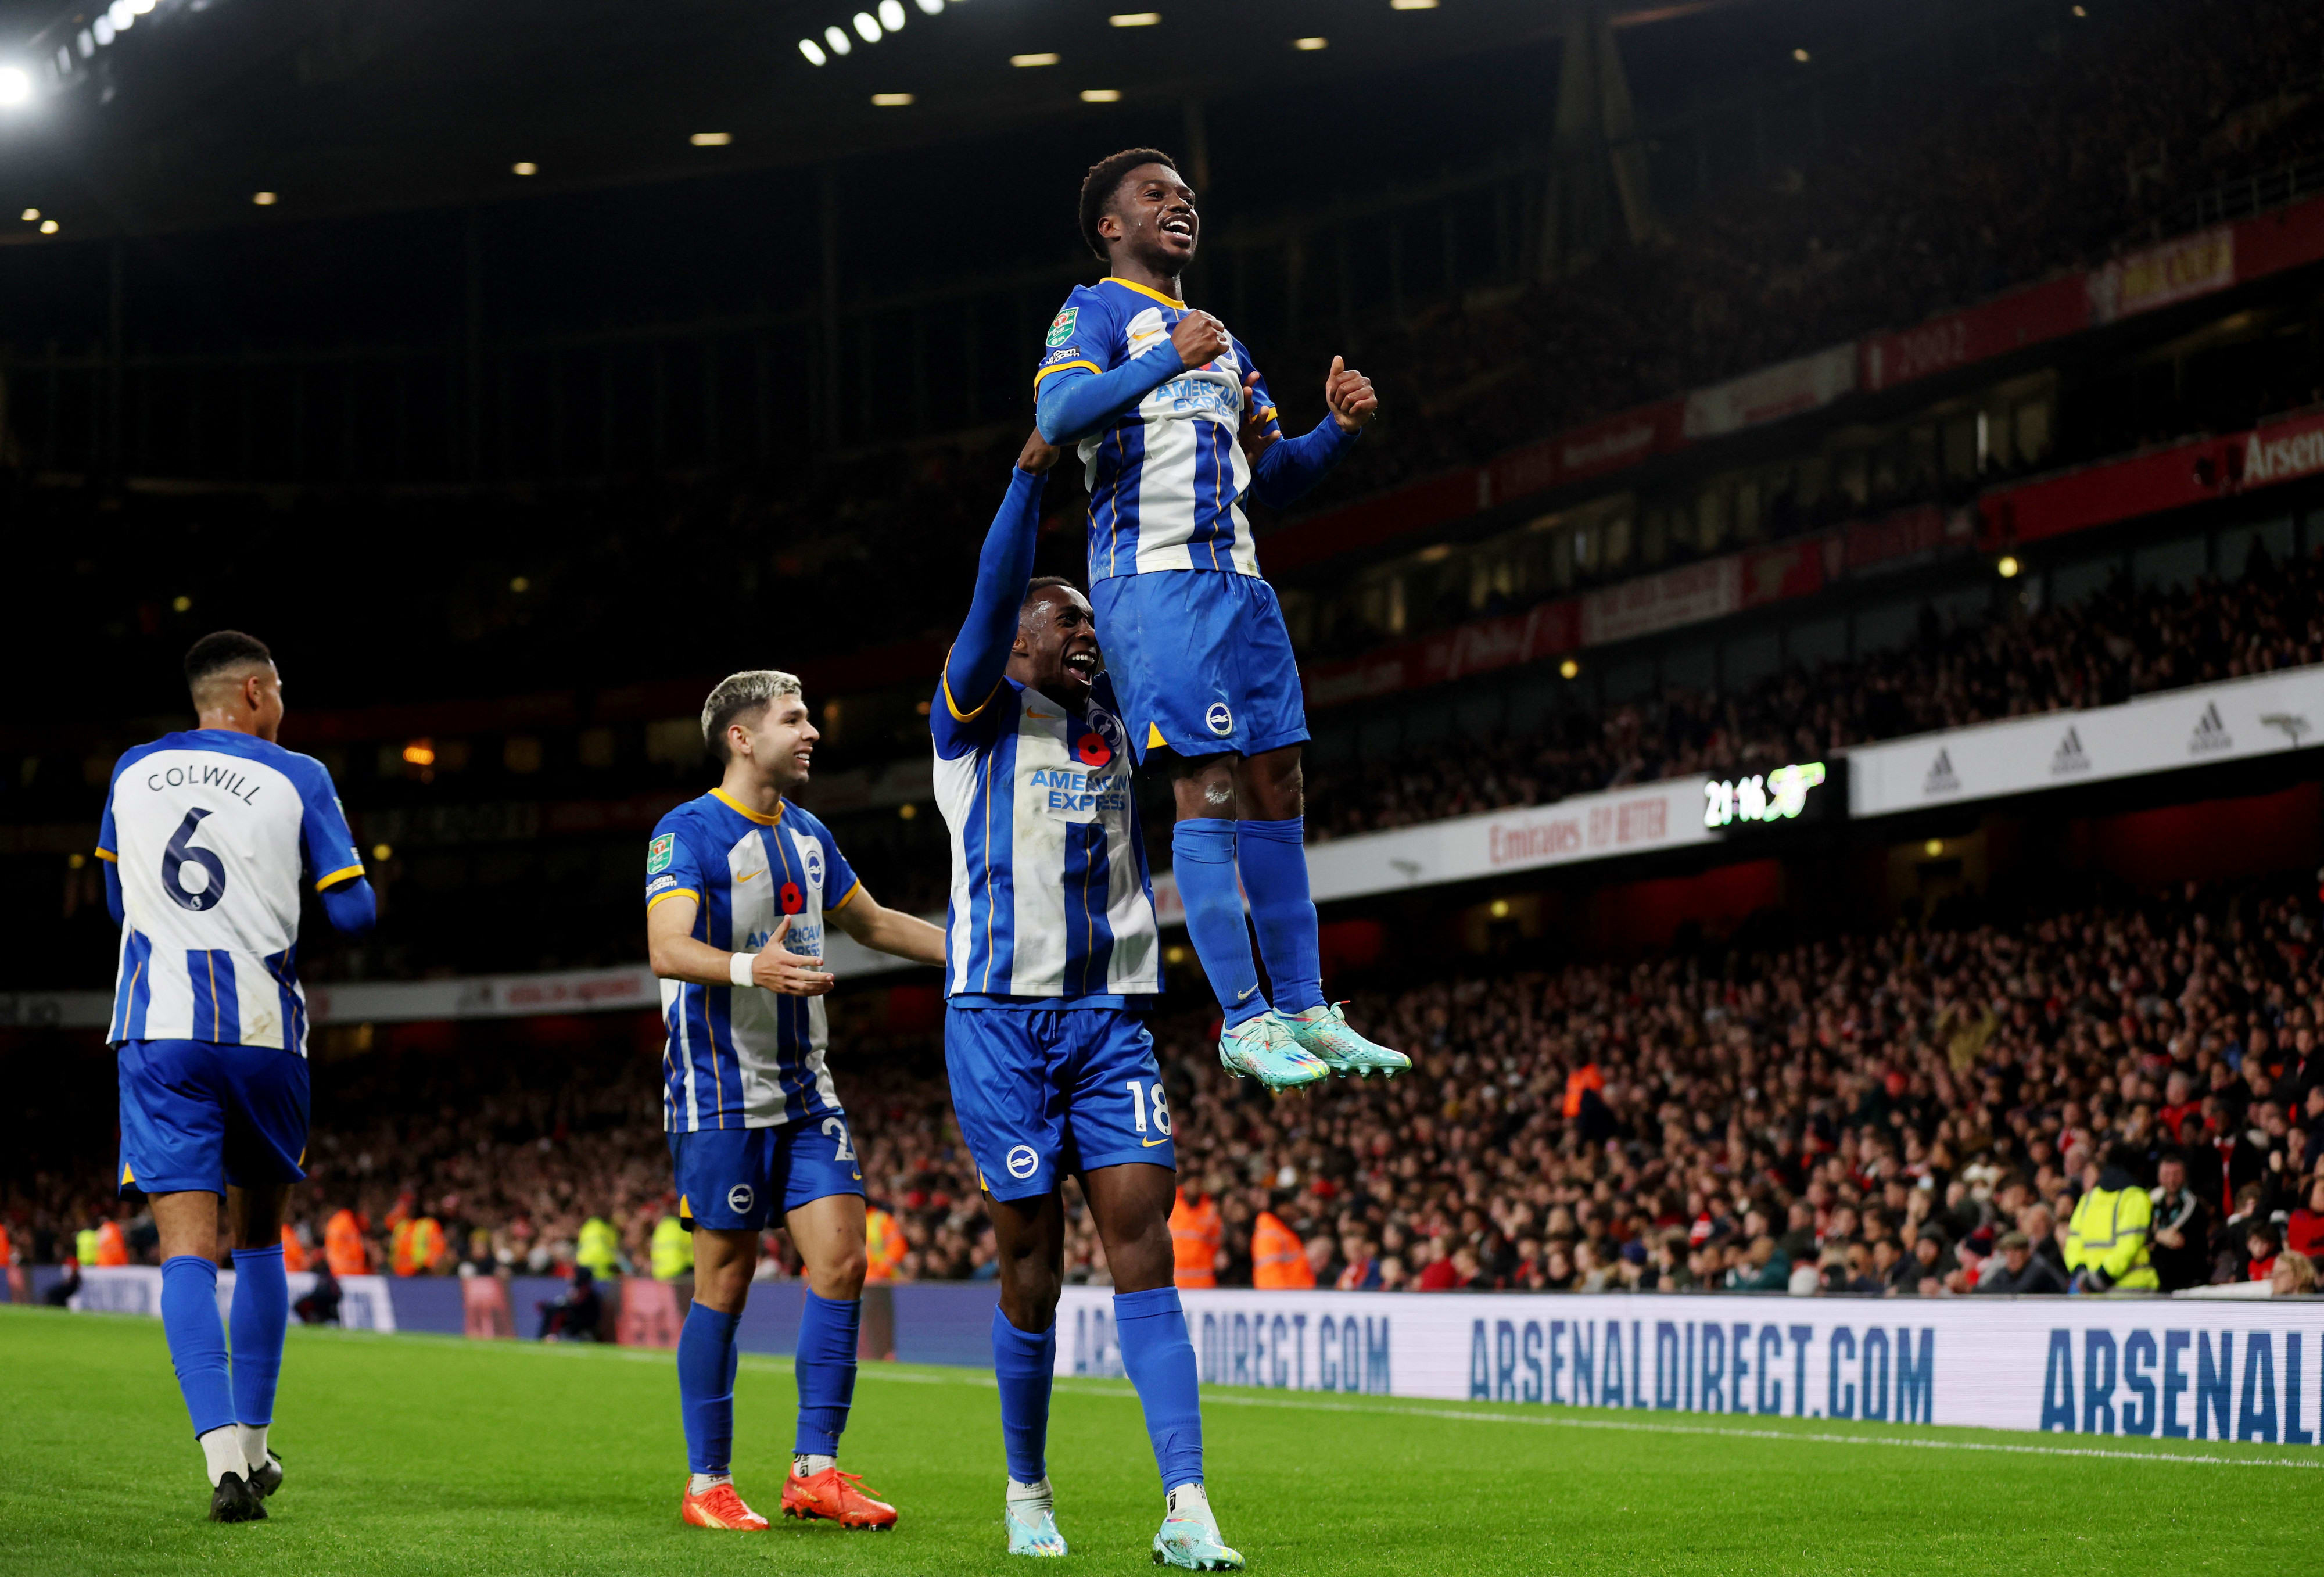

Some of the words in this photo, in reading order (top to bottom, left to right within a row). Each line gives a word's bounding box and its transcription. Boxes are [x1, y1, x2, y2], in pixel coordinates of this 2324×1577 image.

[1155, 379, 1239, 408] AMERAN
[148, 765, 260, 806] COLWILL
[162, 806, 226, 912] 6
[1127, 1081, 1172, 1135] 18
[822, 1117, 855, 1161] 2
[1470, 1319, 1935, 1424] ARSENALDIRECT.COM
[2040, 1328, 2324, 1445] ARSENAL
